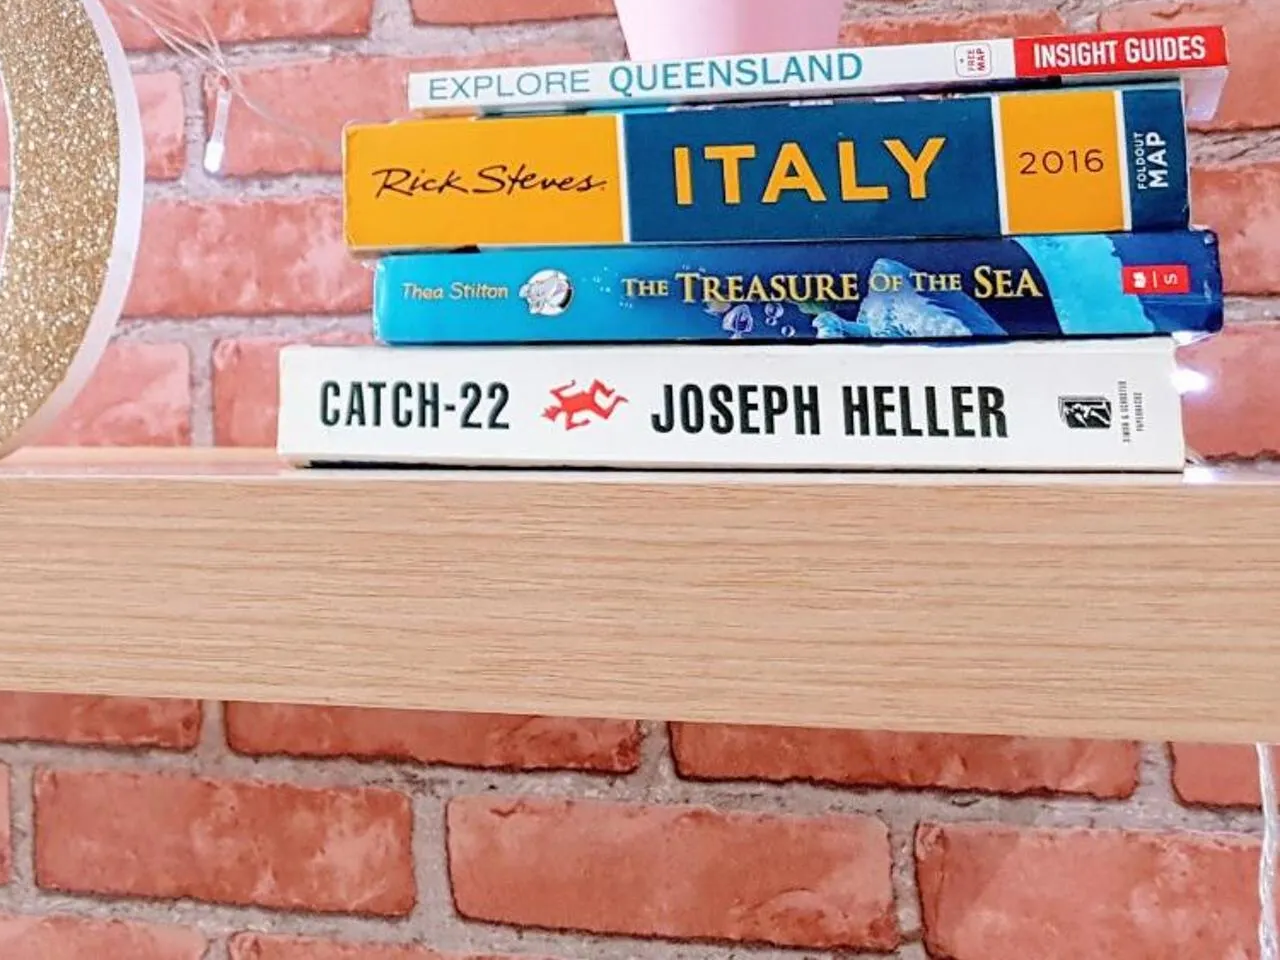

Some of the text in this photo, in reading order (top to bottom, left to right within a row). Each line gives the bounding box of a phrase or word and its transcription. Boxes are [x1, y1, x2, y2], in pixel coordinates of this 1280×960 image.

[976, 47, 986, 72] MAP
[1033, 35, 1206, 69] INSIGHT GUIDES
[428, 52, 863, 100] EXPLORE QUEENSLAND
[371, 163, 607, 199] Rick Steves
[673, 136, 947, 206] ITALY
[1018, 148, 1105, 175] 2016
[1133, 131, 1147, 190] FOLDOUT
[1145, 131, 1169, 188] MAP
[403, 281, 509, 301] Thea Stilton
[621, 277, 669, 298] THE
[674, 271, 860, 304] TREASURE
[909, 271, 963, 292] THE
[973, 265, 1044, 299] SEA
[320, 380, 511, 430] CATCH-22
[650, 383, 1009, 438] JOSEPH HELLER
